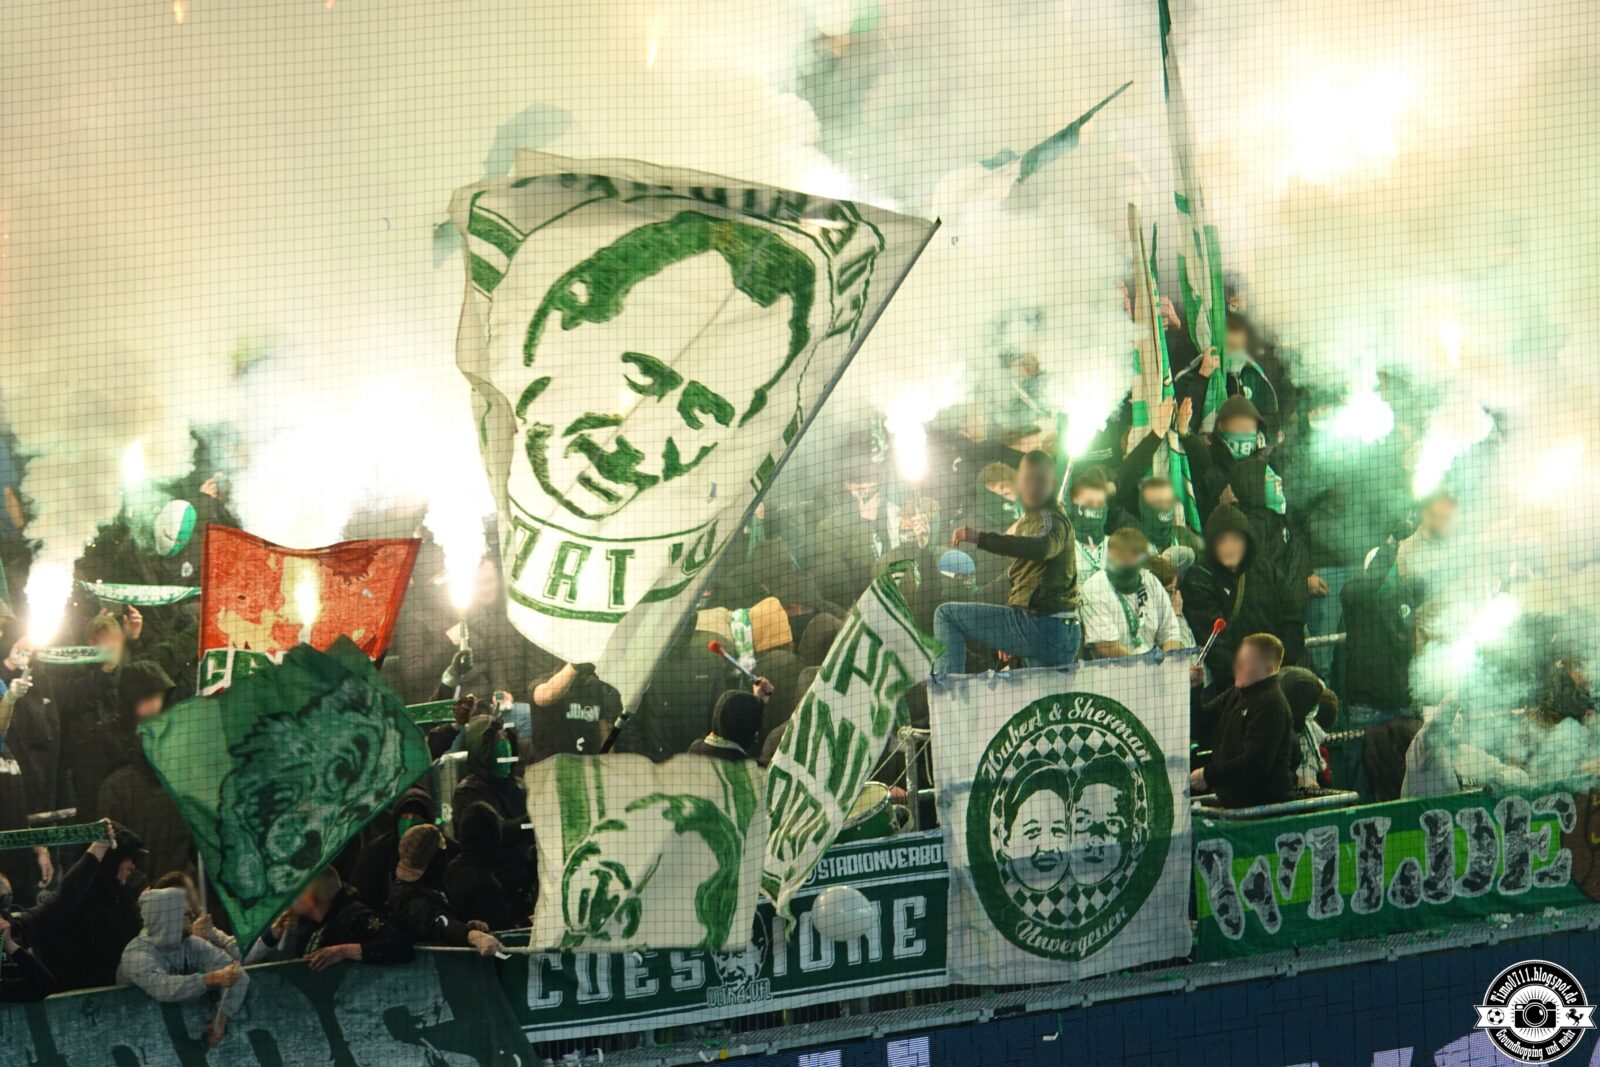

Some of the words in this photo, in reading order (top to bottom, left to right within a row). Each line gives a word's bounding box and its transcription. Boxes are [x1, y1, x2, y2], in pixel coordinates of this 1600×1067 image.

[981, 709, 1042, 782] Hubert
[1049, 703, 1062, 721] &
[1068, 696, 1153, 764] Sherman
[817, 843, 947, 880] STADIONVERBO
[1195, 791, 1577, 940] WILDE
